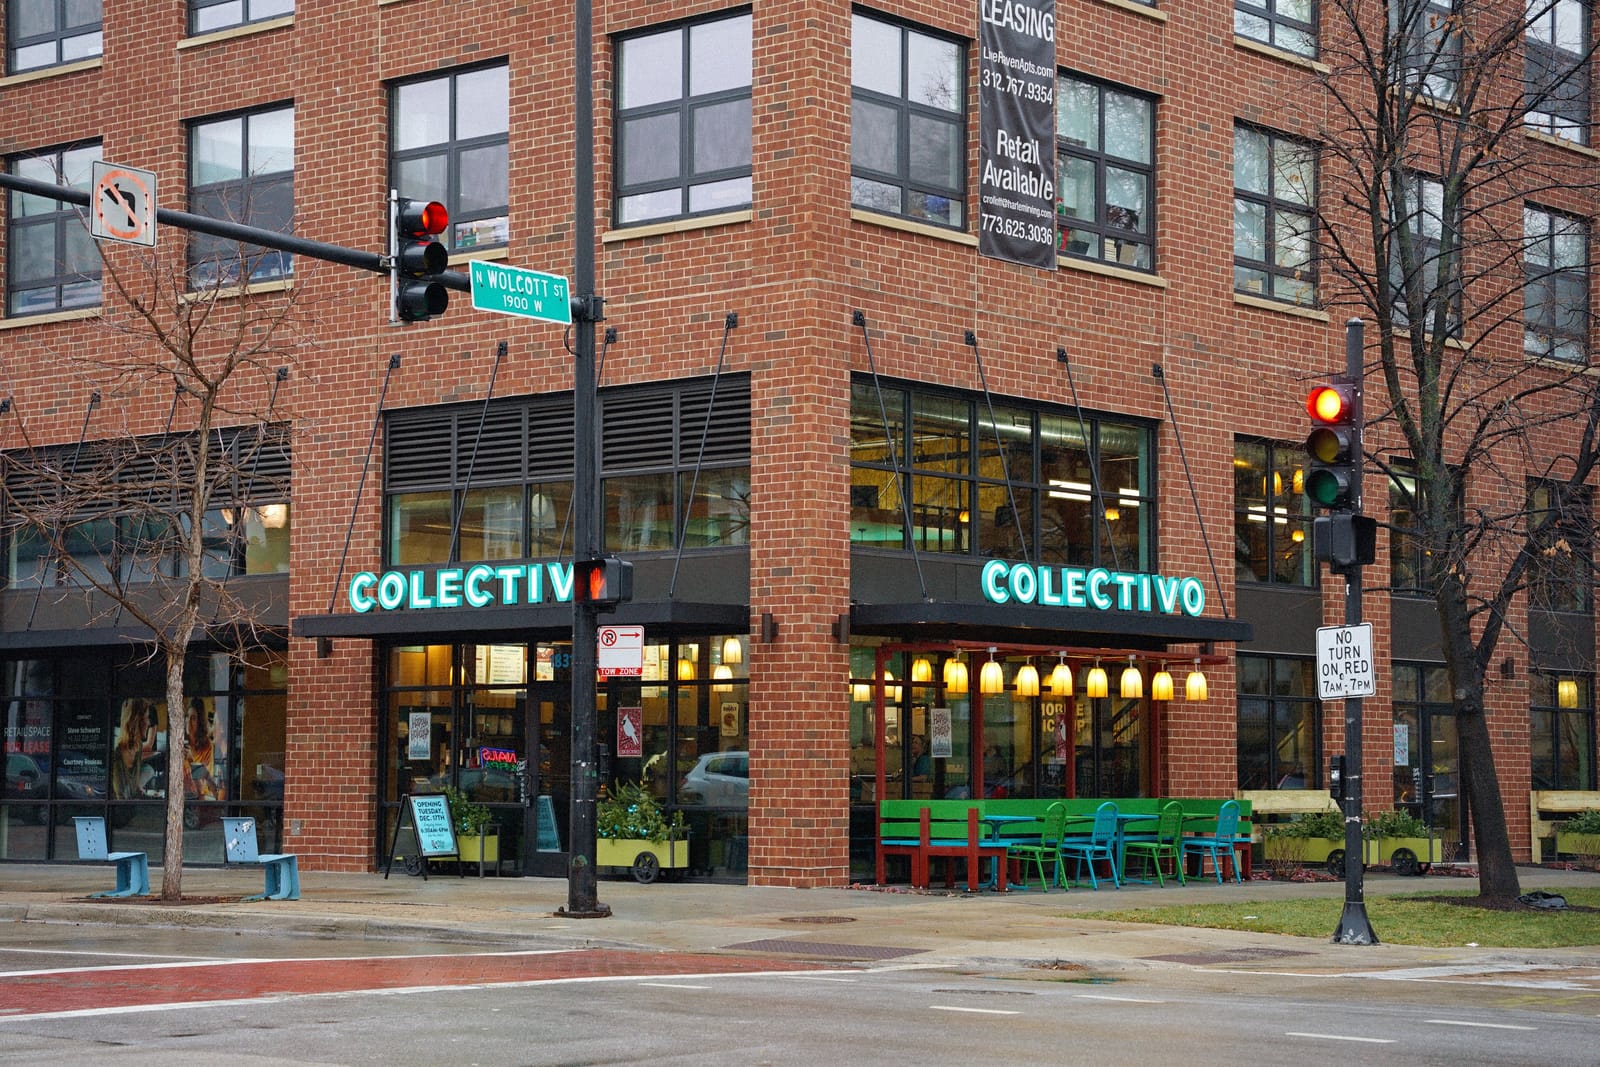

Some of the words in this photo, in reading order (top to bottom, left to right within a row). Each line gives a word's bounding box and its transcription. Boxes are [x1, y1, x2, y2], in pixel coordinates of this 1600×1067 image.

[981, 0, 1054, 42] LEASING
[983, 69, 1053, 105] 312.767.9354
[997, 129, 1040, 165] Retail
[982, 159, 1054, 201] Available
[981, 213, 1053, 245] 773.625.3036
[476, 270, 483, 283] N
[487, 269, 548, 298] WOLCOTT
[553, 284, 564, 297] ST
[503, 294, 528, 310] 1900
[534, 300, 543, 313] W
[349, 562, 574, 613] COLECTIV
[981, 559, 1205, 617] COLECTIVO
[1336, 630, 1352, 644] NO
[551, 654, 573, 668] 183
[1328, 645, 1361, 660] TURN
[1322, 663, 1338, 676] ON
[1345, 660, 1369, 675] RED
[28, 726, 51, 736] SPACE
[3, 741, 22, 753] FOR
[24, 741, 50, 753] LEASE
